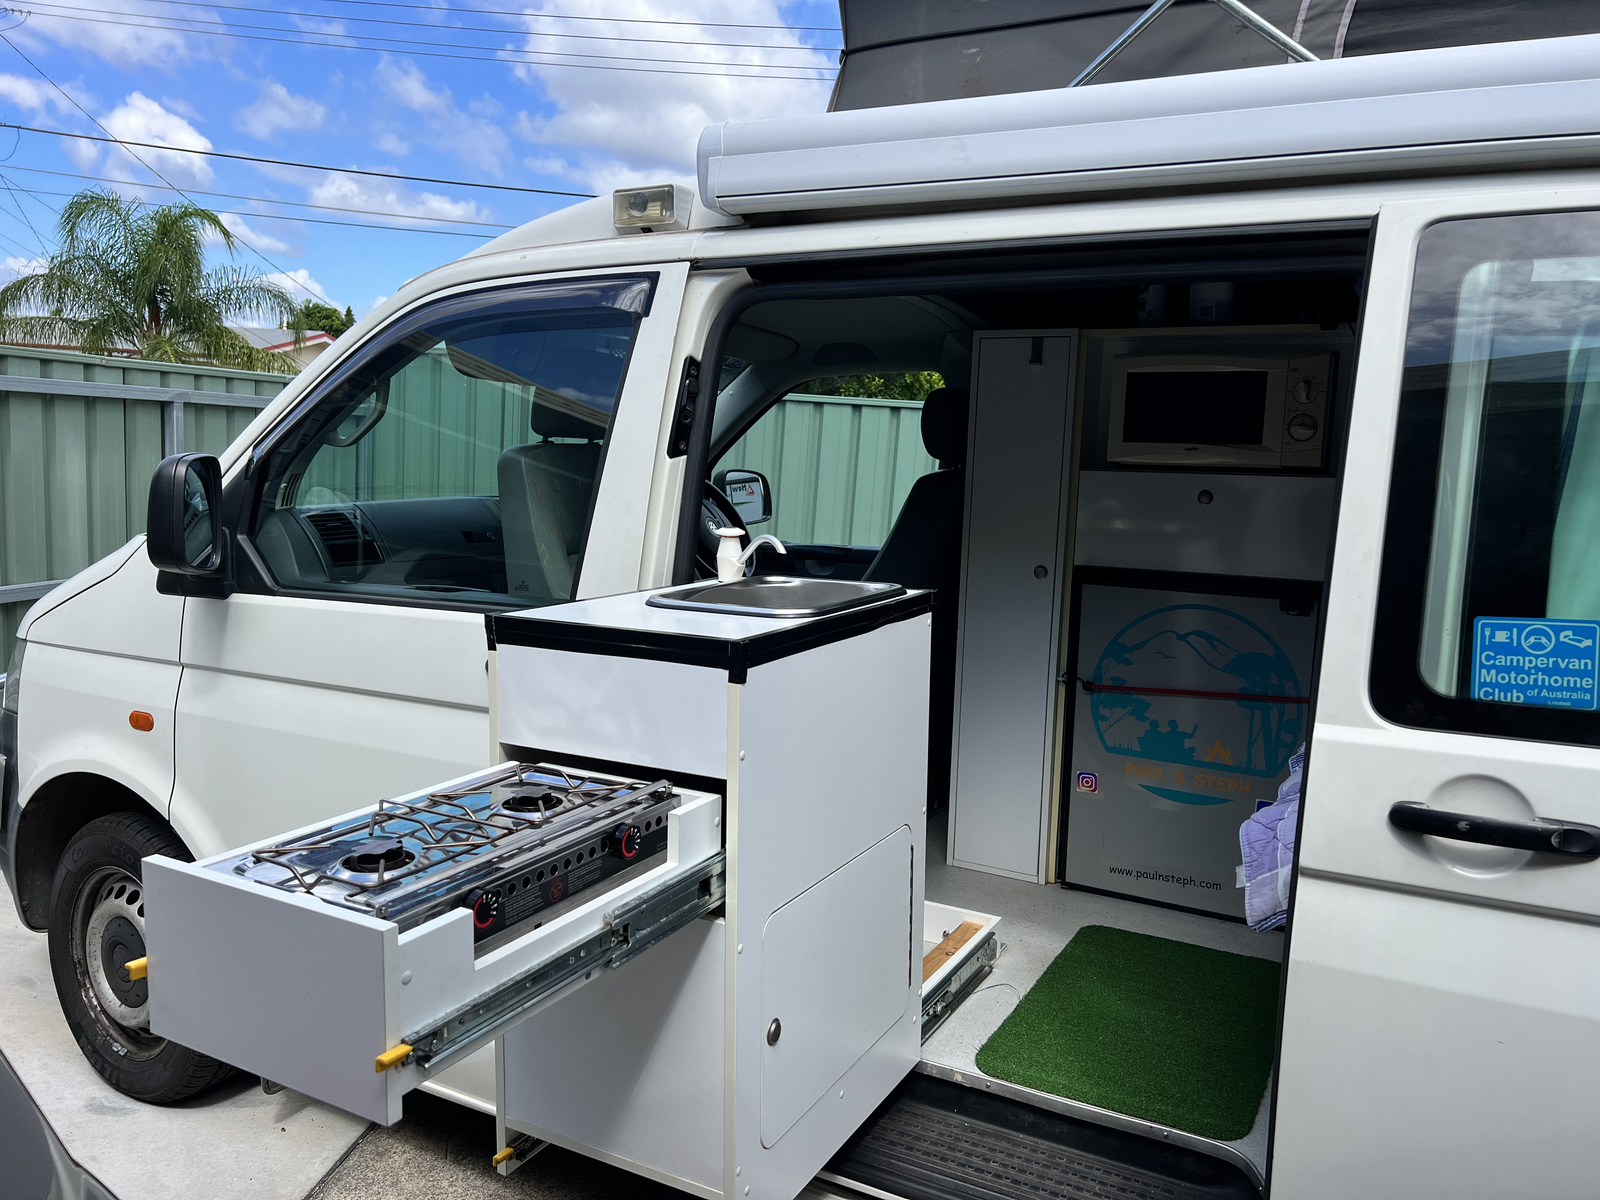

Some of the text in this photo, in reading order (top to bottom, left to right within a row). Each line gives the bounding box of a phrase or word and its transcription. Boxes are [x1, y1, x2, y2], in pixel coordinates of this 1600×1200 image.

[1481, 651, 1592, 670] Campervan
[1480, 669, 1593, 688] Motorhome
[1480, 687, 1591, 703] Club of Australia
[1125, 762, 1251, 795] PAUL & STEPH
[1109, 866, 1222, 891] www.paulnsteph.com
